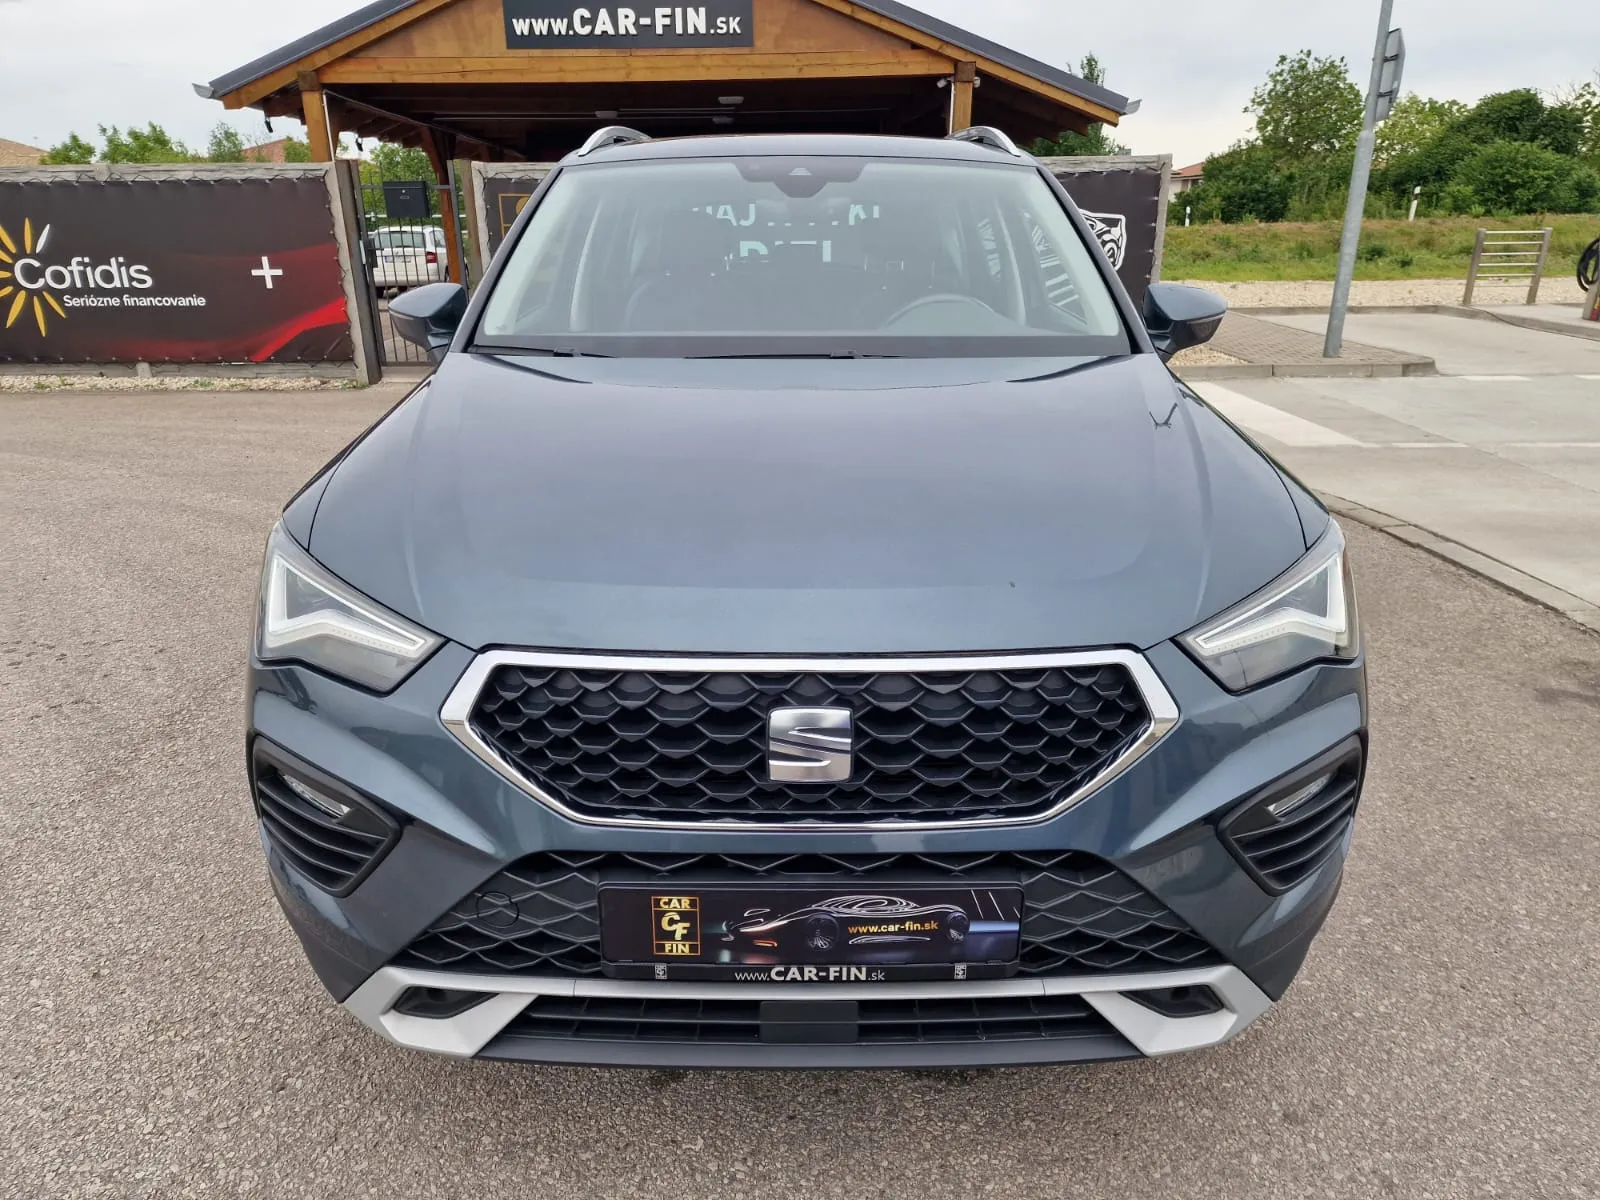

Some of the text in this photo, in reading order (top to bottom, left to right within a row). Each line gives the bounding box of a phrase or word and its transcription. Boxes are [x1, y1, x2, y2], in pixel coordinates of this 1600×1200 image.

[14, 256, 153, 289] Cofidis
[63, 294, 206, 307] Seriózne financovanie
[660, 898, 690, 909] CAR
[848, 921, 939, 934] www.car-fin.sk
[665, 943, 690, 954] FIN
[735, 964, 885, 982] www.CAR-FIN.sk
